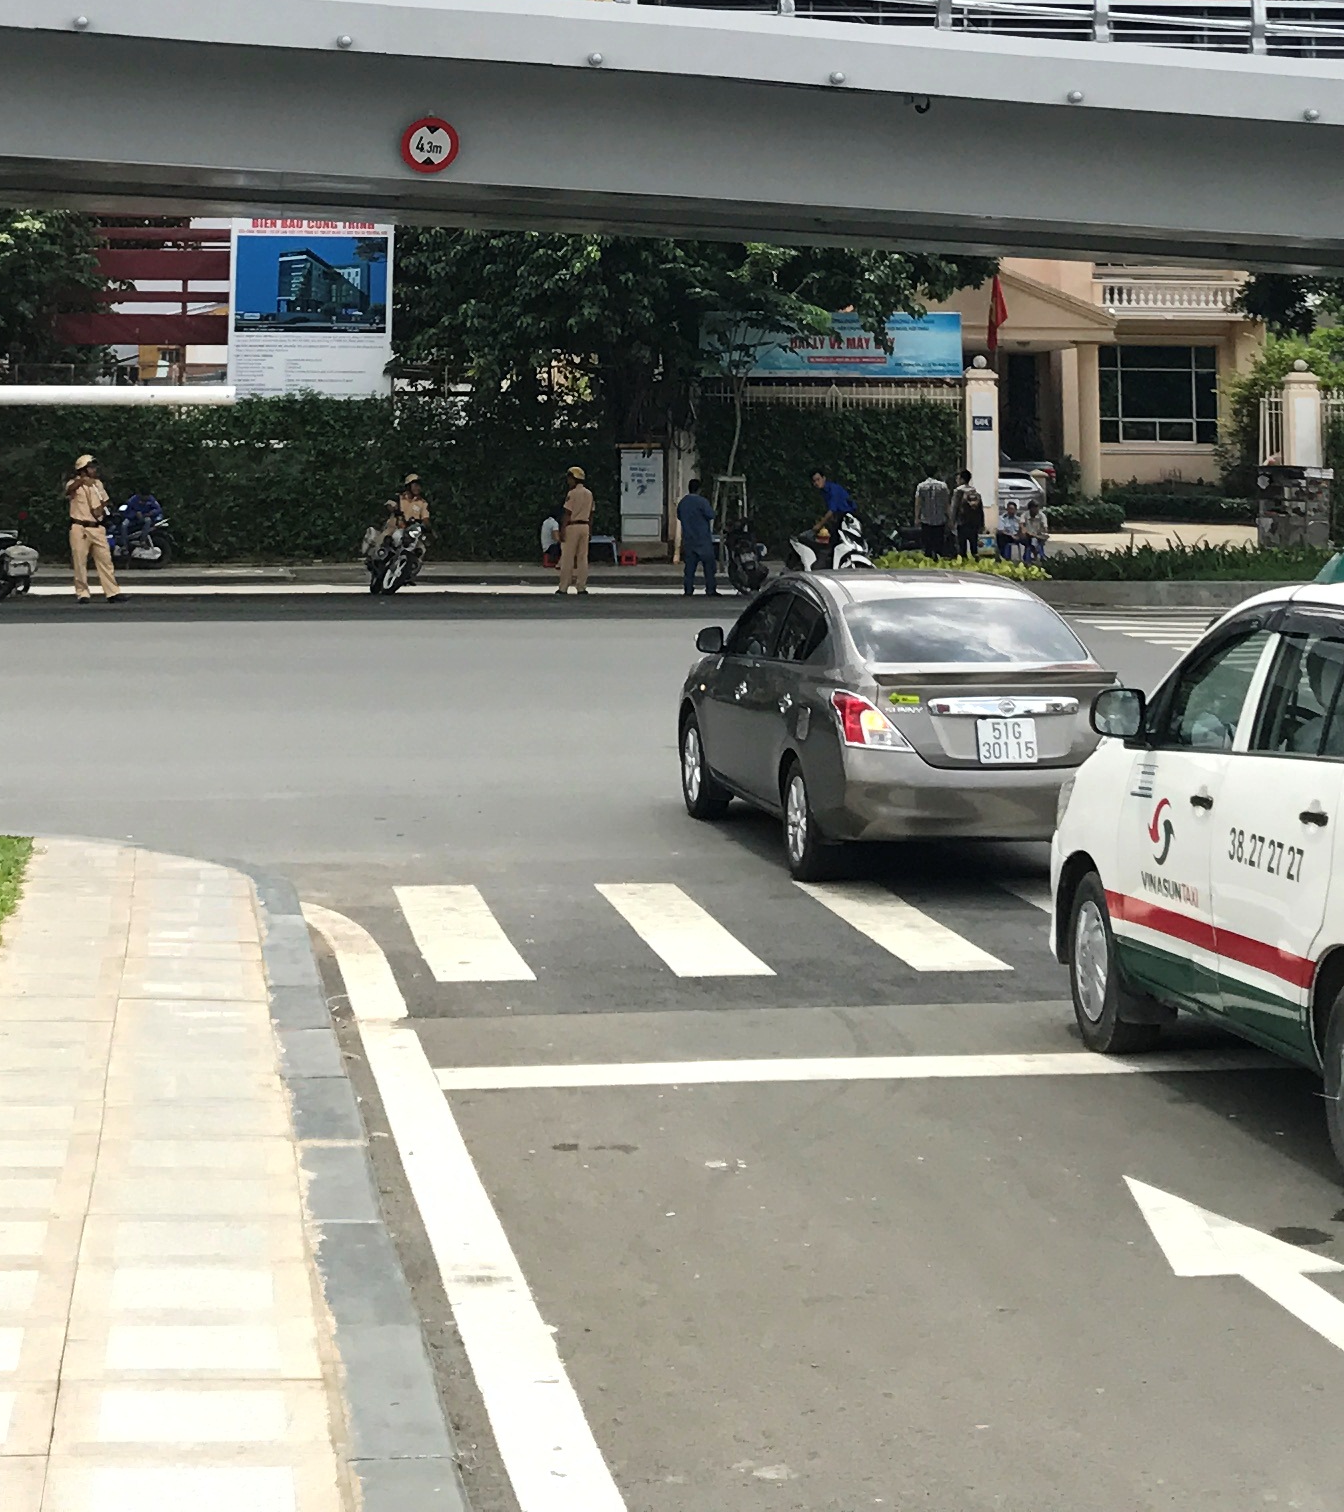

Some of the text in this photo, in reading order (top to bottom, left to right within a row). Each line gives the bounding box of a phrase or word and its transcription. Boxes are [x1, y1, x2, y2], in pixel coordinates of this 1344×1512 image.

[992, 722, 1022, 740] 51G
[982, 741, 1035, 760] 301.15
[1228, 827, 1305, 882] 38.27 27 27
